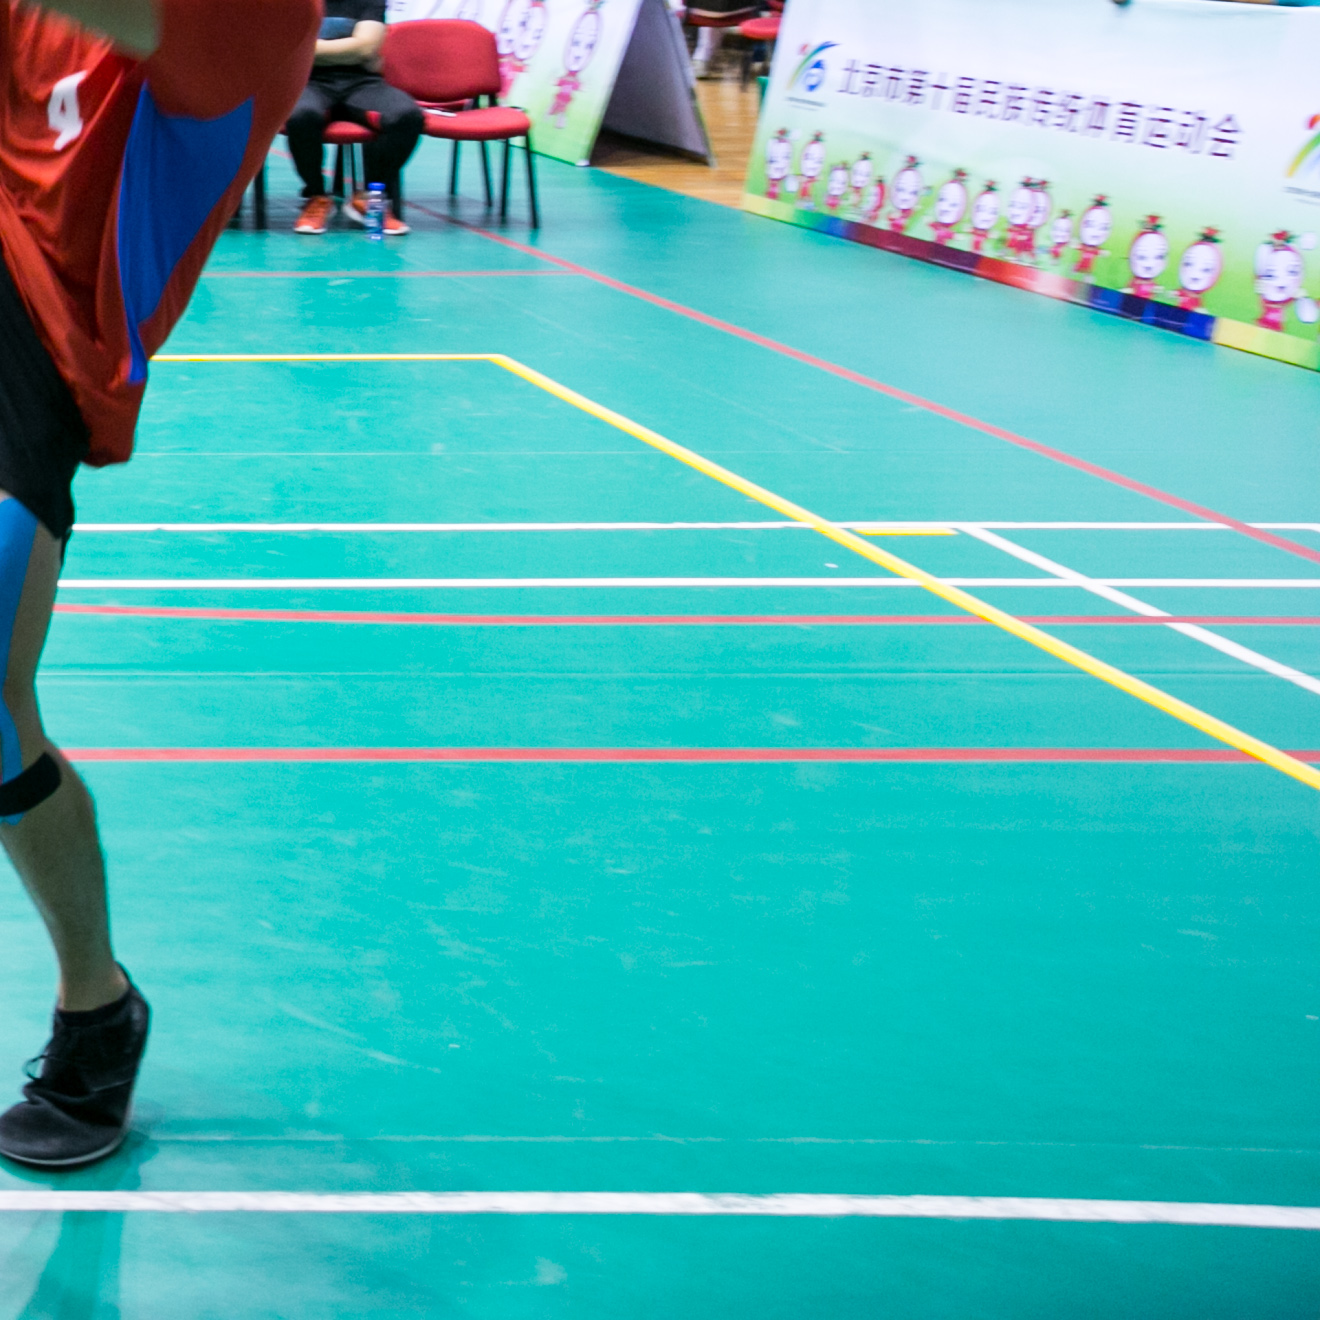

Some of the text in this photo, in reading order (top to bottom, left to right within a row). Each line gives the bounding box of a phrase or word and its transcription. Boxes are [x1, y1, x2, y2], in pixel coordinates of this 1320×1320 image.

[838, 58, 1245, 160] 北京市第十届民族传统体育运动会
